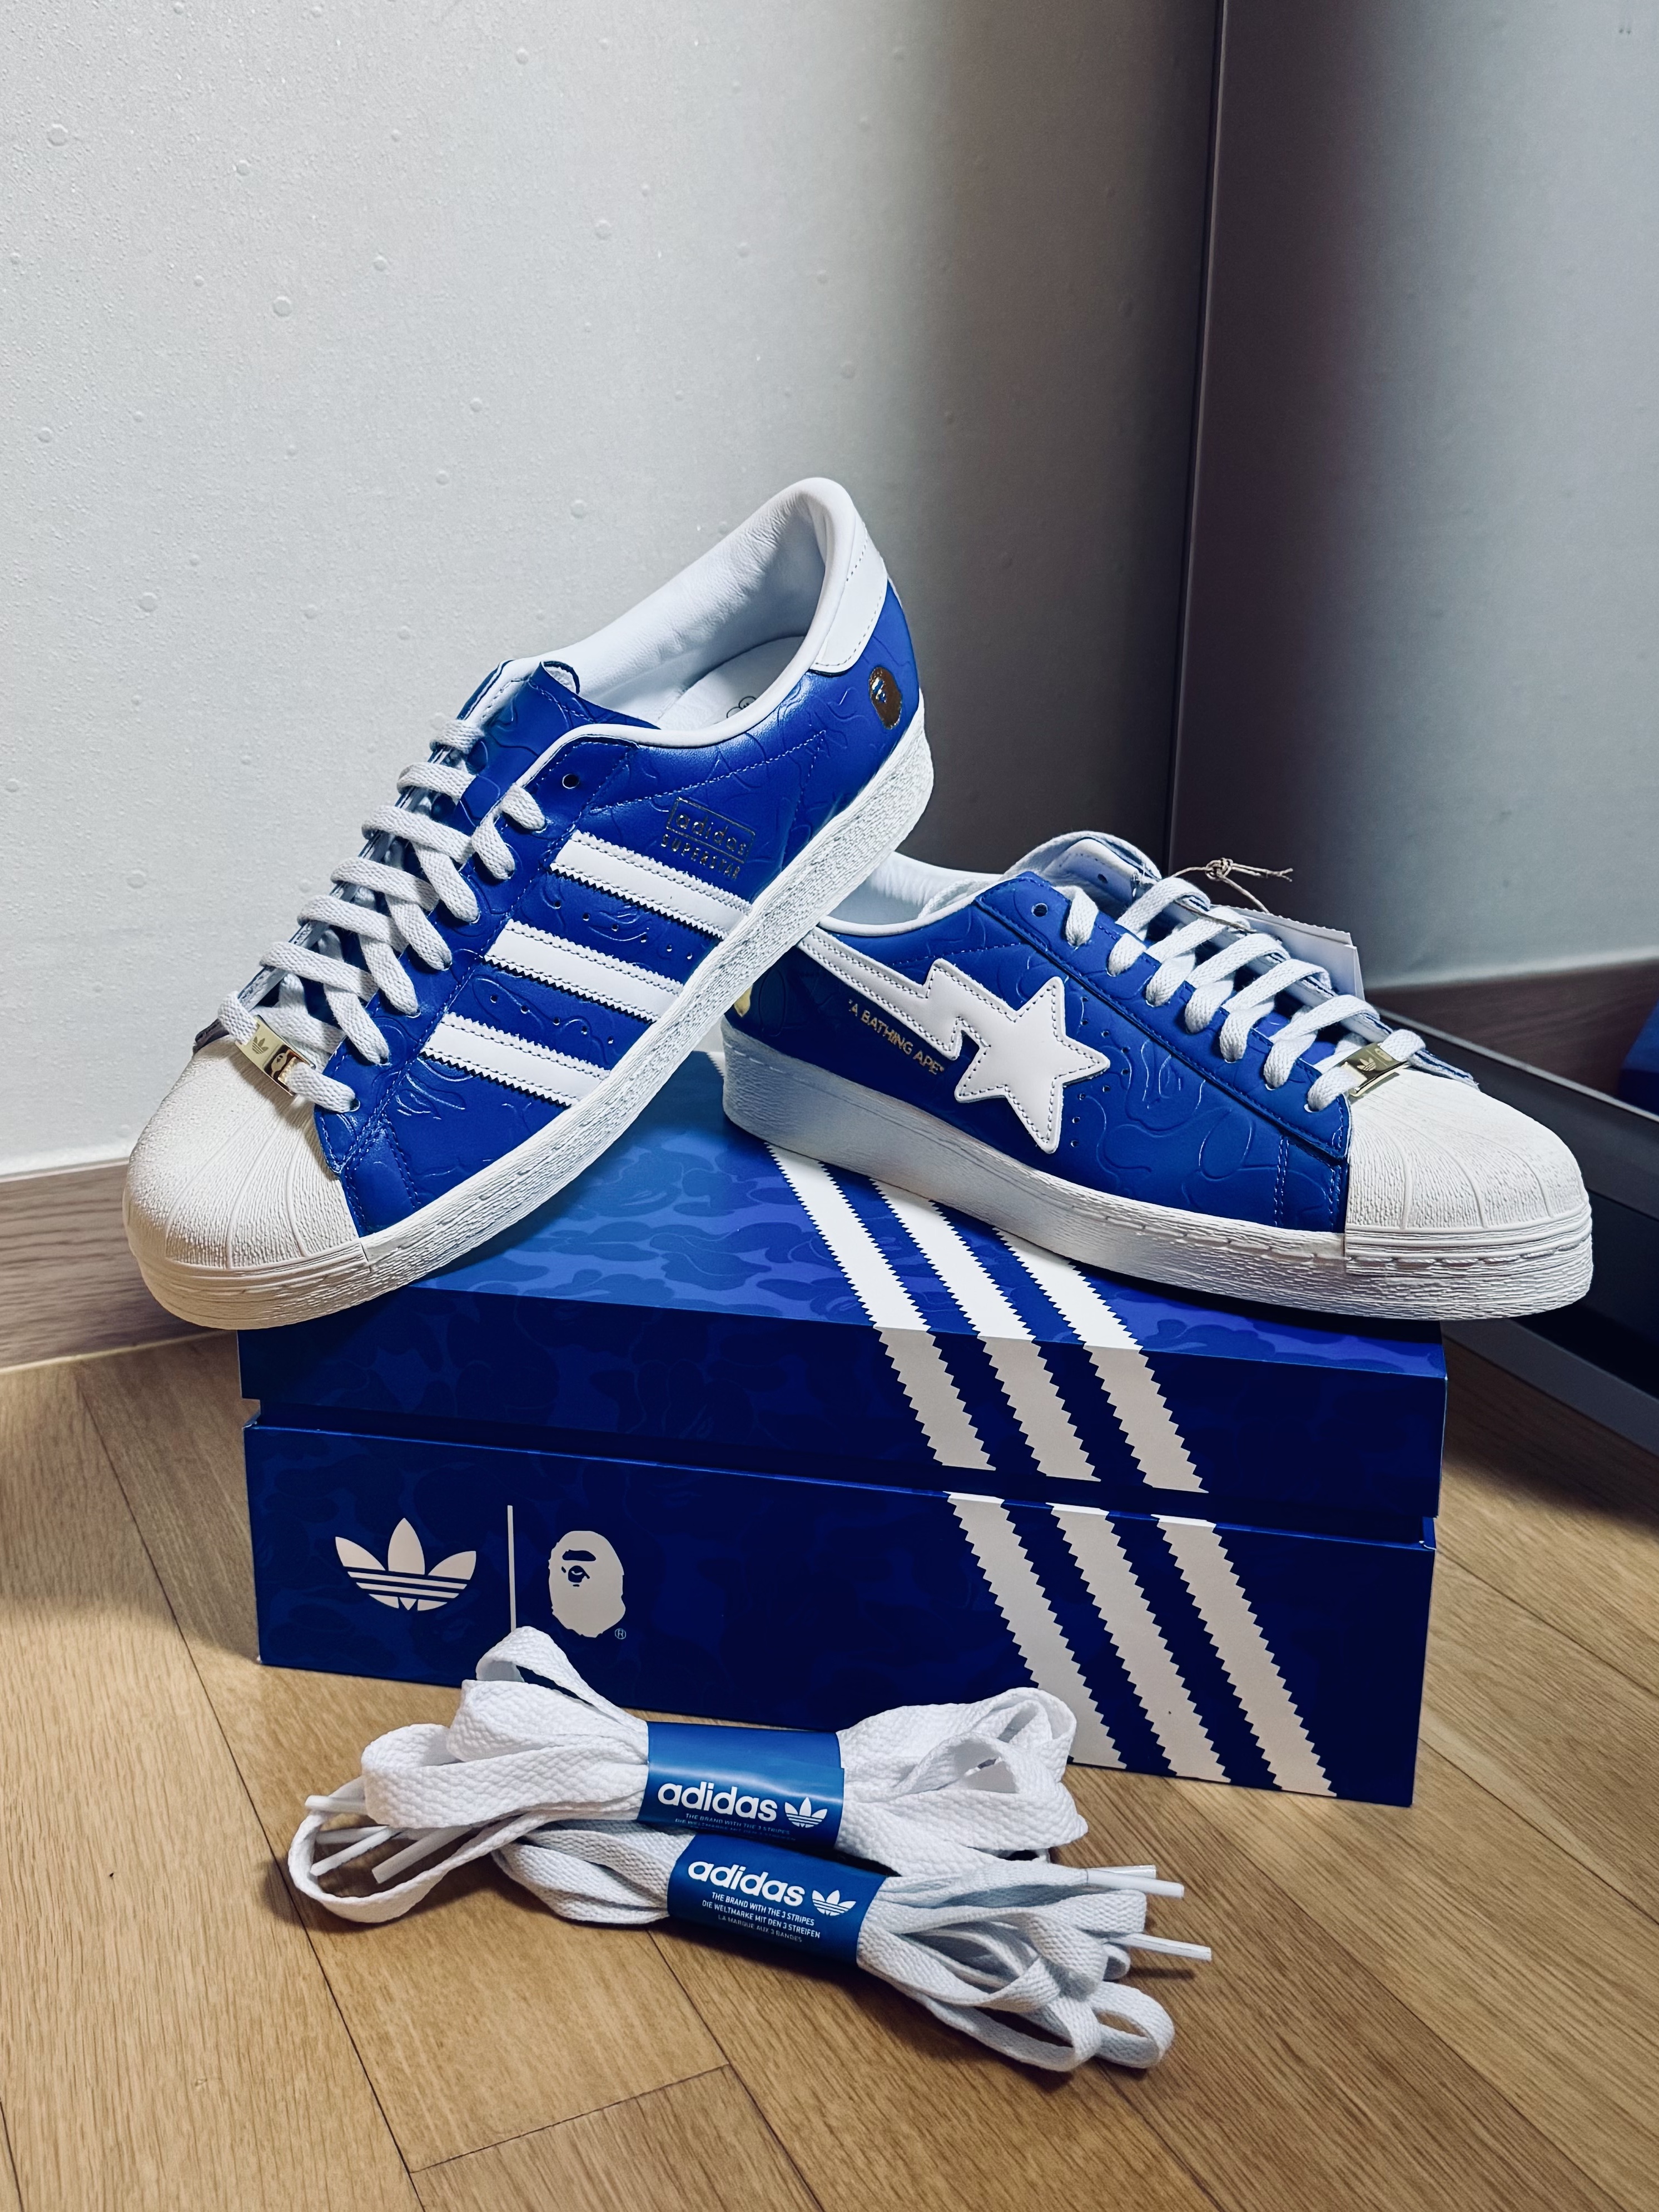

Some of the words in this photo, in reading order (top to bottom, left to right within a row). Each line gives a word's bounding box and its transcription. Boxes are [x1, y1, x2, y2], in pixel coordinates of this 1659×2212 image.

[675, 814, 746, 855] adidas
[660, 834, 741, 880] SUPERSTAR
[861, 1009, 913, 1055] BATHING
[658, 1781, 778, 1822] adidas
[699, 1816, 723, 1824] BRAND
[688, 1861, 806, 1906] adidas
[702, 1899, 713, 1908] DIE
[714, 1903, 754, 1920] WELTMARKE
[755, 1915, 767, 1923] MIT
[768, 1918, 782, 1928] DEN
[788, 1924, 821, 1939] STREIFEN
[712, 1892, 725, 1902] THE
[726, 1896, 748, 1908] BRAND
[749, 1902, 767, 1913] WITH
[768, 1907, 781, 1917] THE
[787, 1912, 814, 1926] STRIPES
